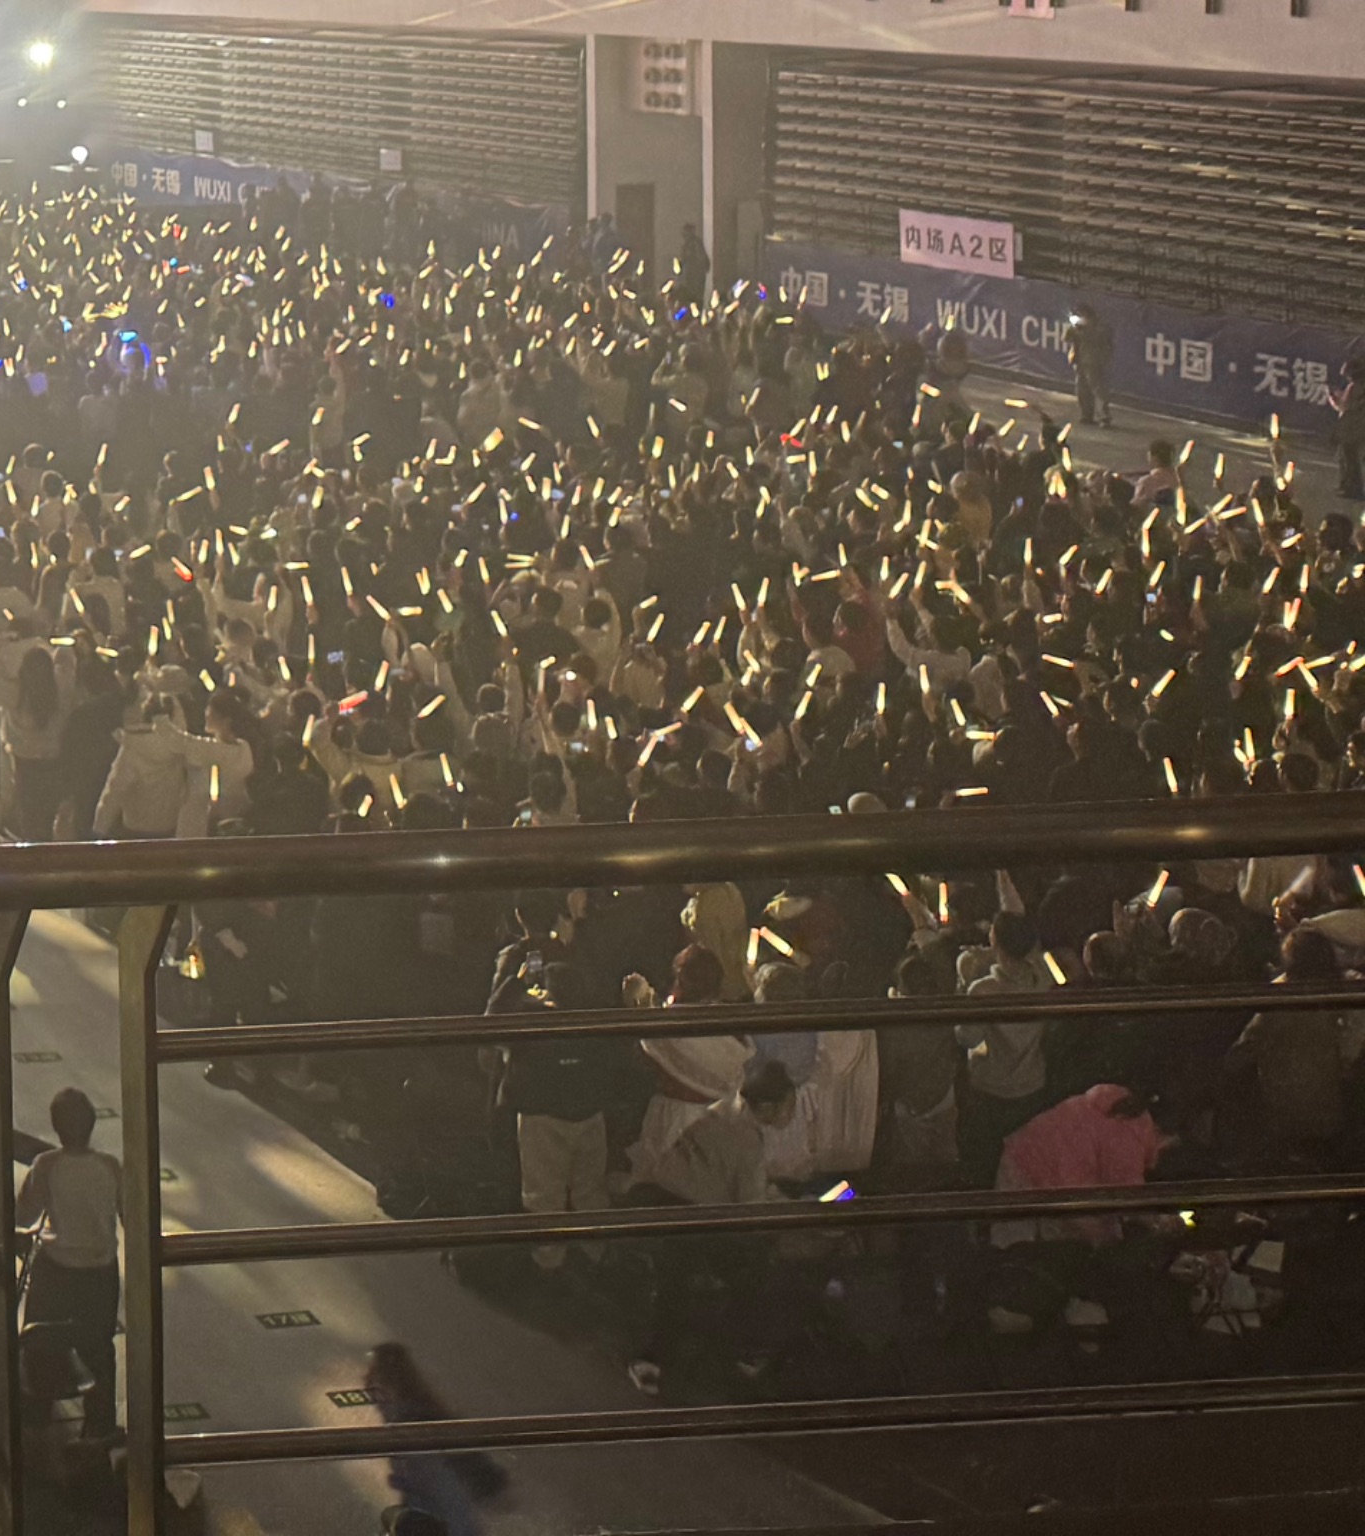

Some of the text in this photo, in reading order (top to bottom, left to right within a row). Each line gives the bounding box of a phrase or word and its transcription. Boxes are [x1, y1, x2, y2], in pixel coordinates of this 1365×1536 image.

[194, 176, 232, 203] WUXI
[905, 224, 1007, 262] 内场A2区
[936, 297, 1007, 341] WUXI
